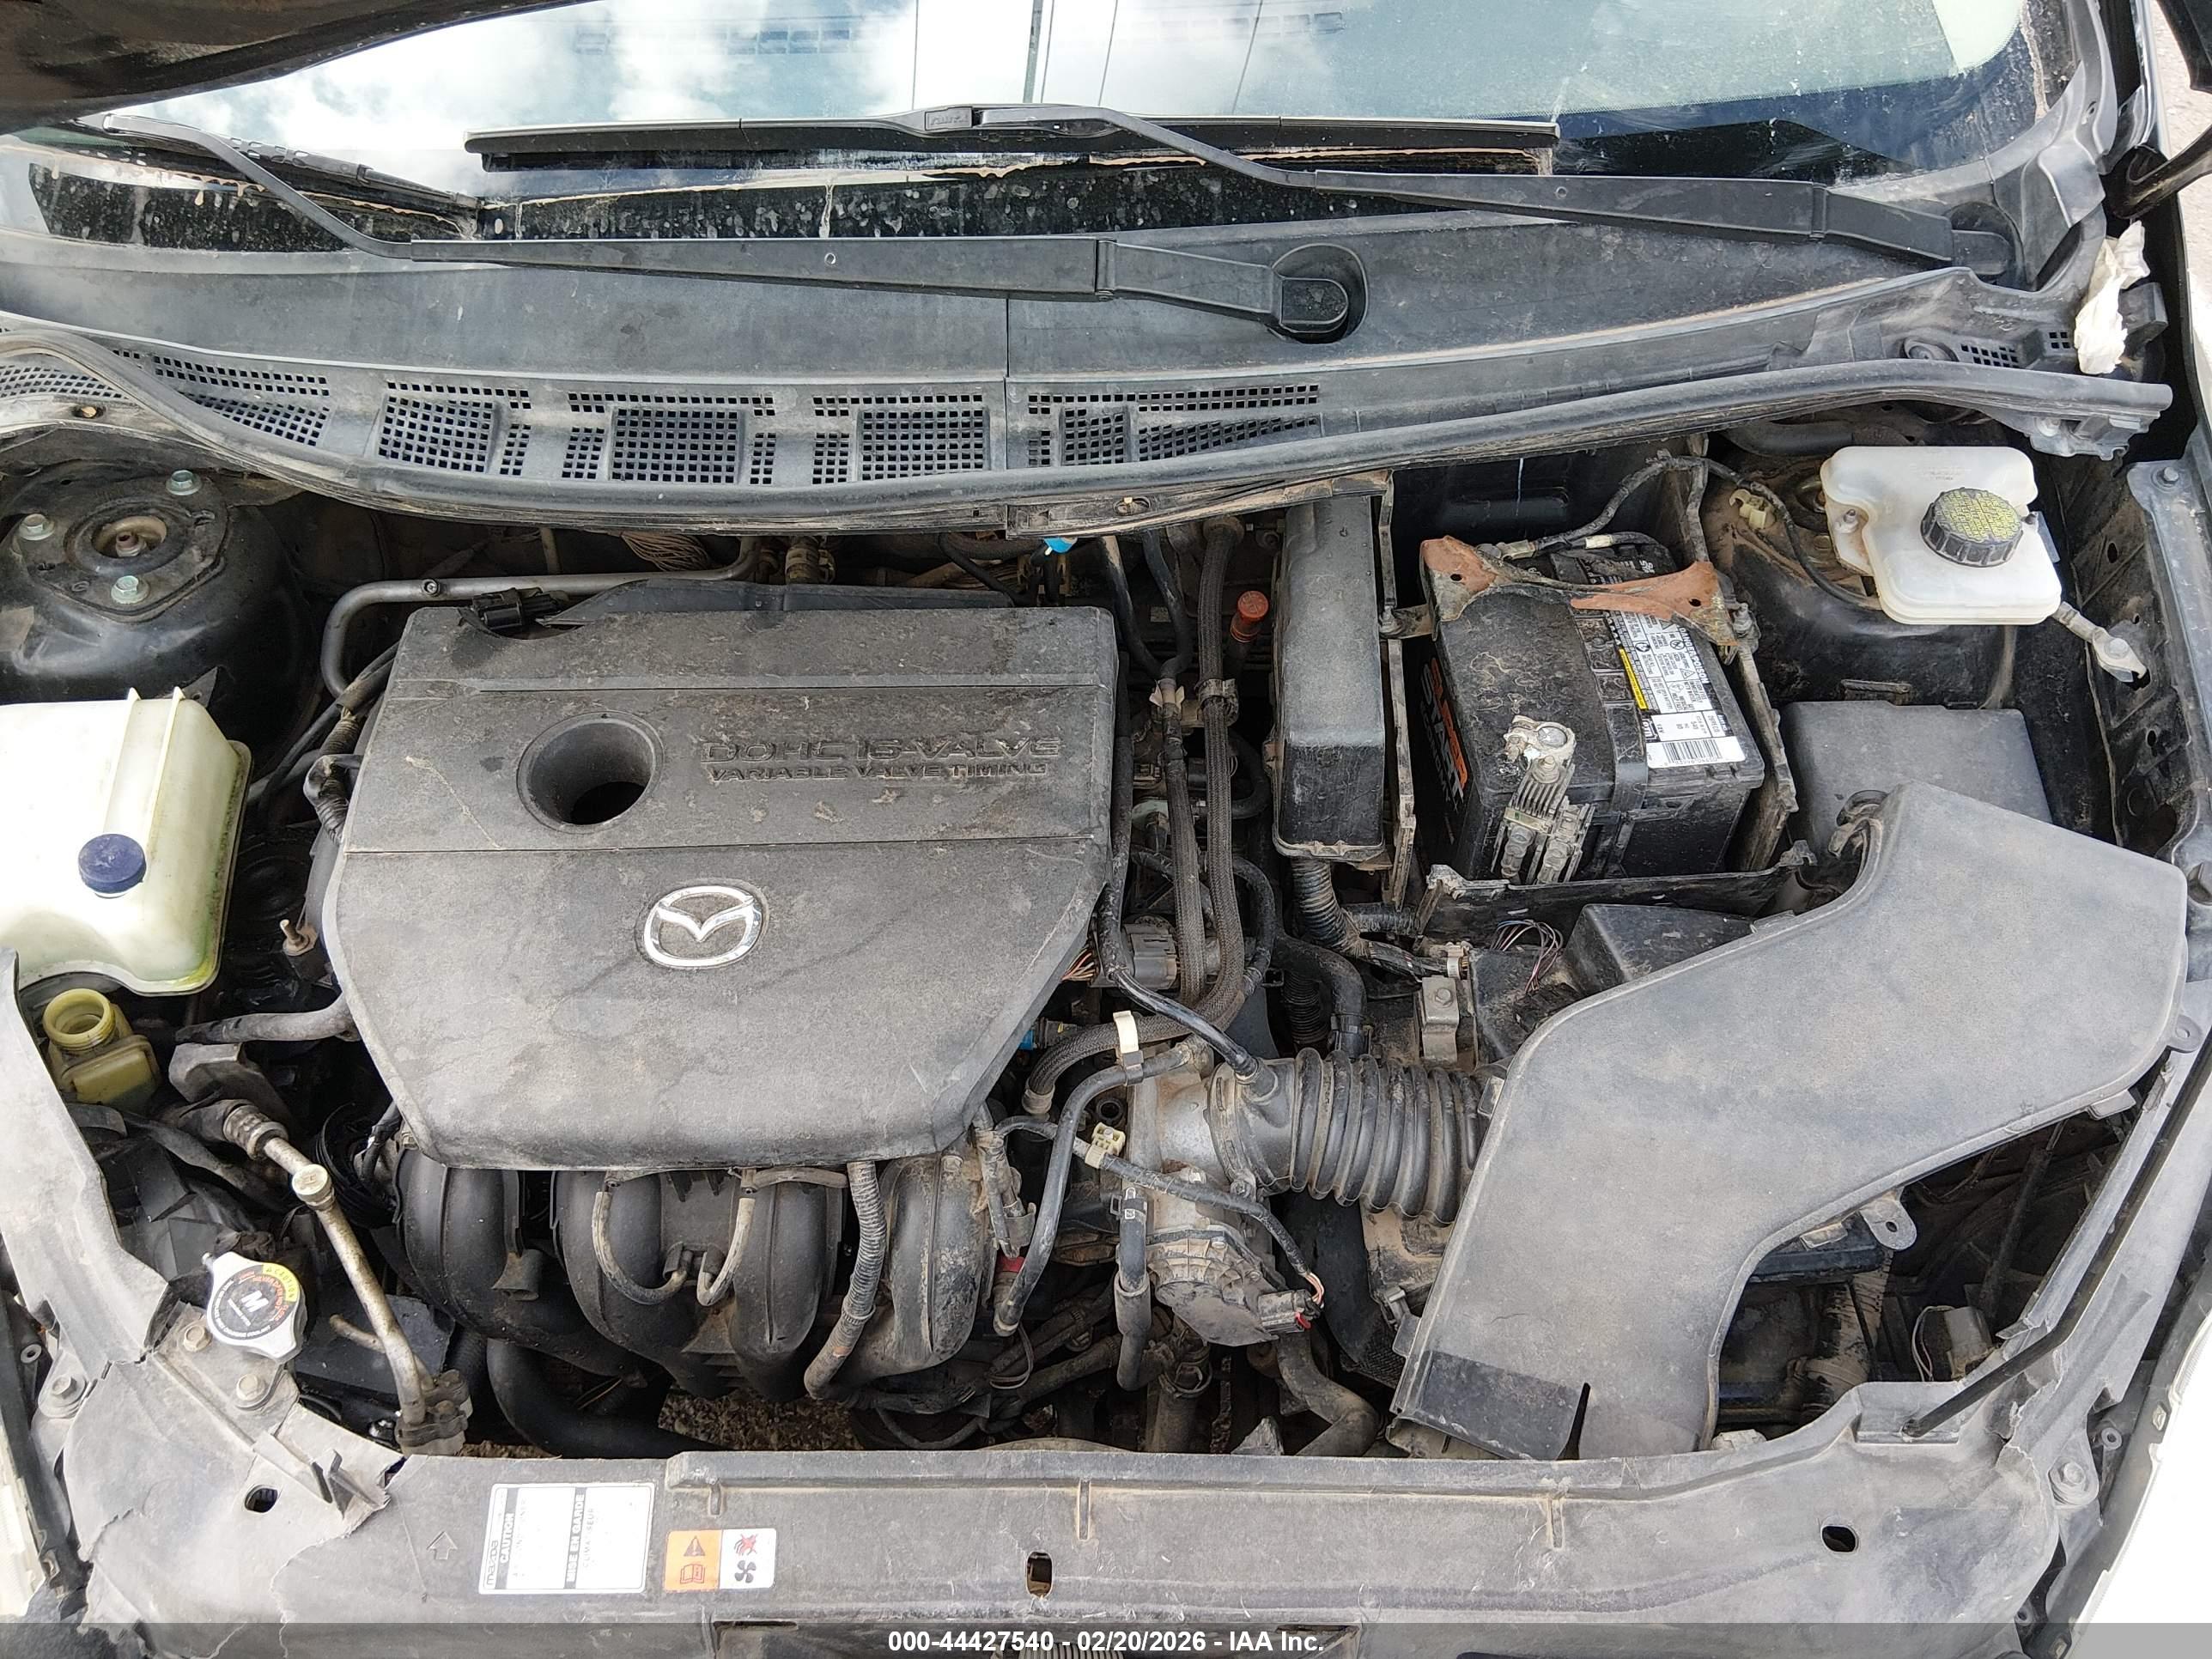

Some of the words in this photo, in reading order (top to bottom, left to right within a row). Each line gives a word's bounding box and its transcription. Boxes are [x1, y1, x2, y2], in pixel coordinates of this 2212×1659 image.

[701, 740, 846, 763] DOHC
[857, 737, 1060, 762] 16-VALVE
[708, 766, 848, 781] VARIABLE
[857, 764, 940, 781] VALVE
[949, 763, 1048, 779] TIMING
[572, 1493, 585, 1534] GARDE
[500, 1512, 515, 1564] CAUTION
[569, 1535, 580, 1553] EN
[566, 1553, 579, 1583] MISE
